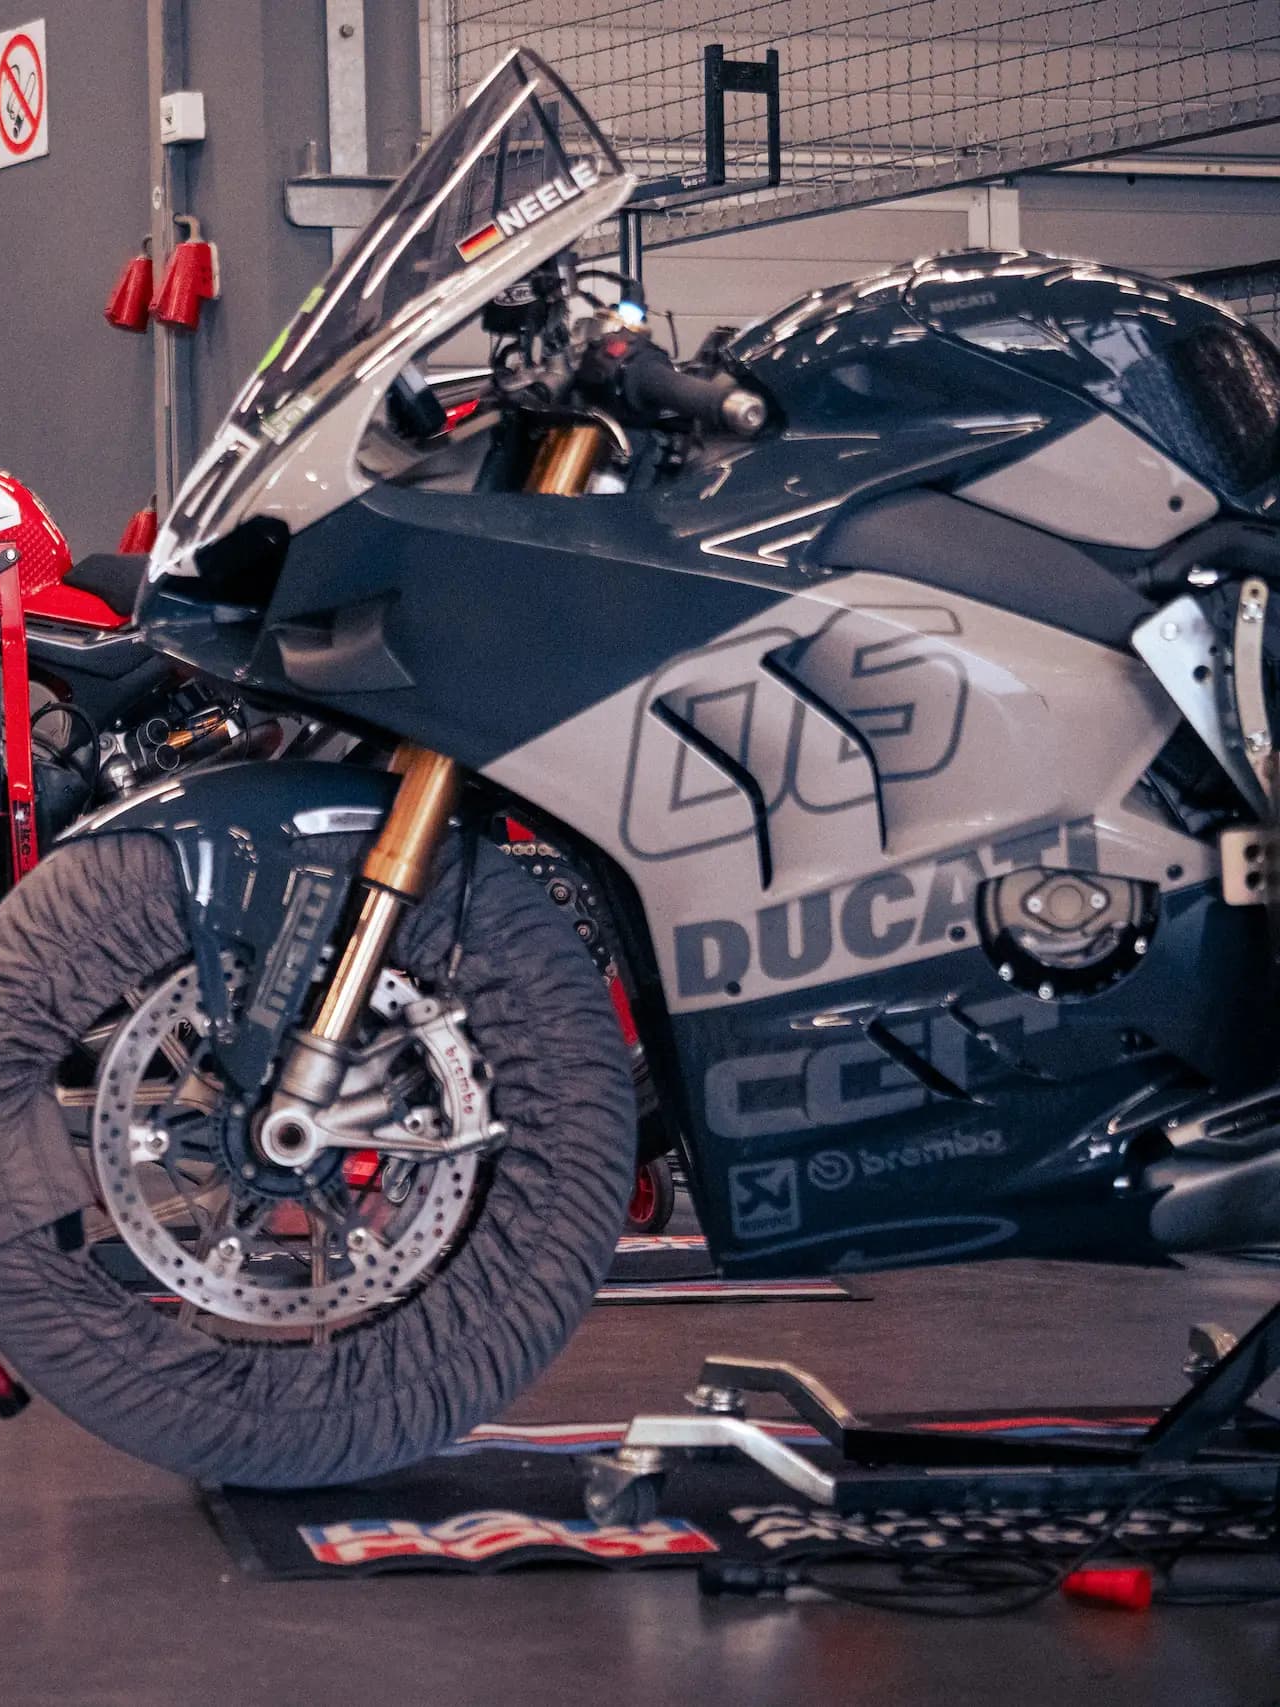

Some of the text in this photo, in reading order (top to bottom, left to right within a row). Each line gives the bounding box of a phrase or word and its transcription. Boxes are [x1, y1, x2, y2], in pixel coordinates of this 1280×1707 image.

[495, 159, 600, 236] NEELE
[444, 1044, 476, 1115] brembo
[859, 1127, 1009, 1177] brembo
